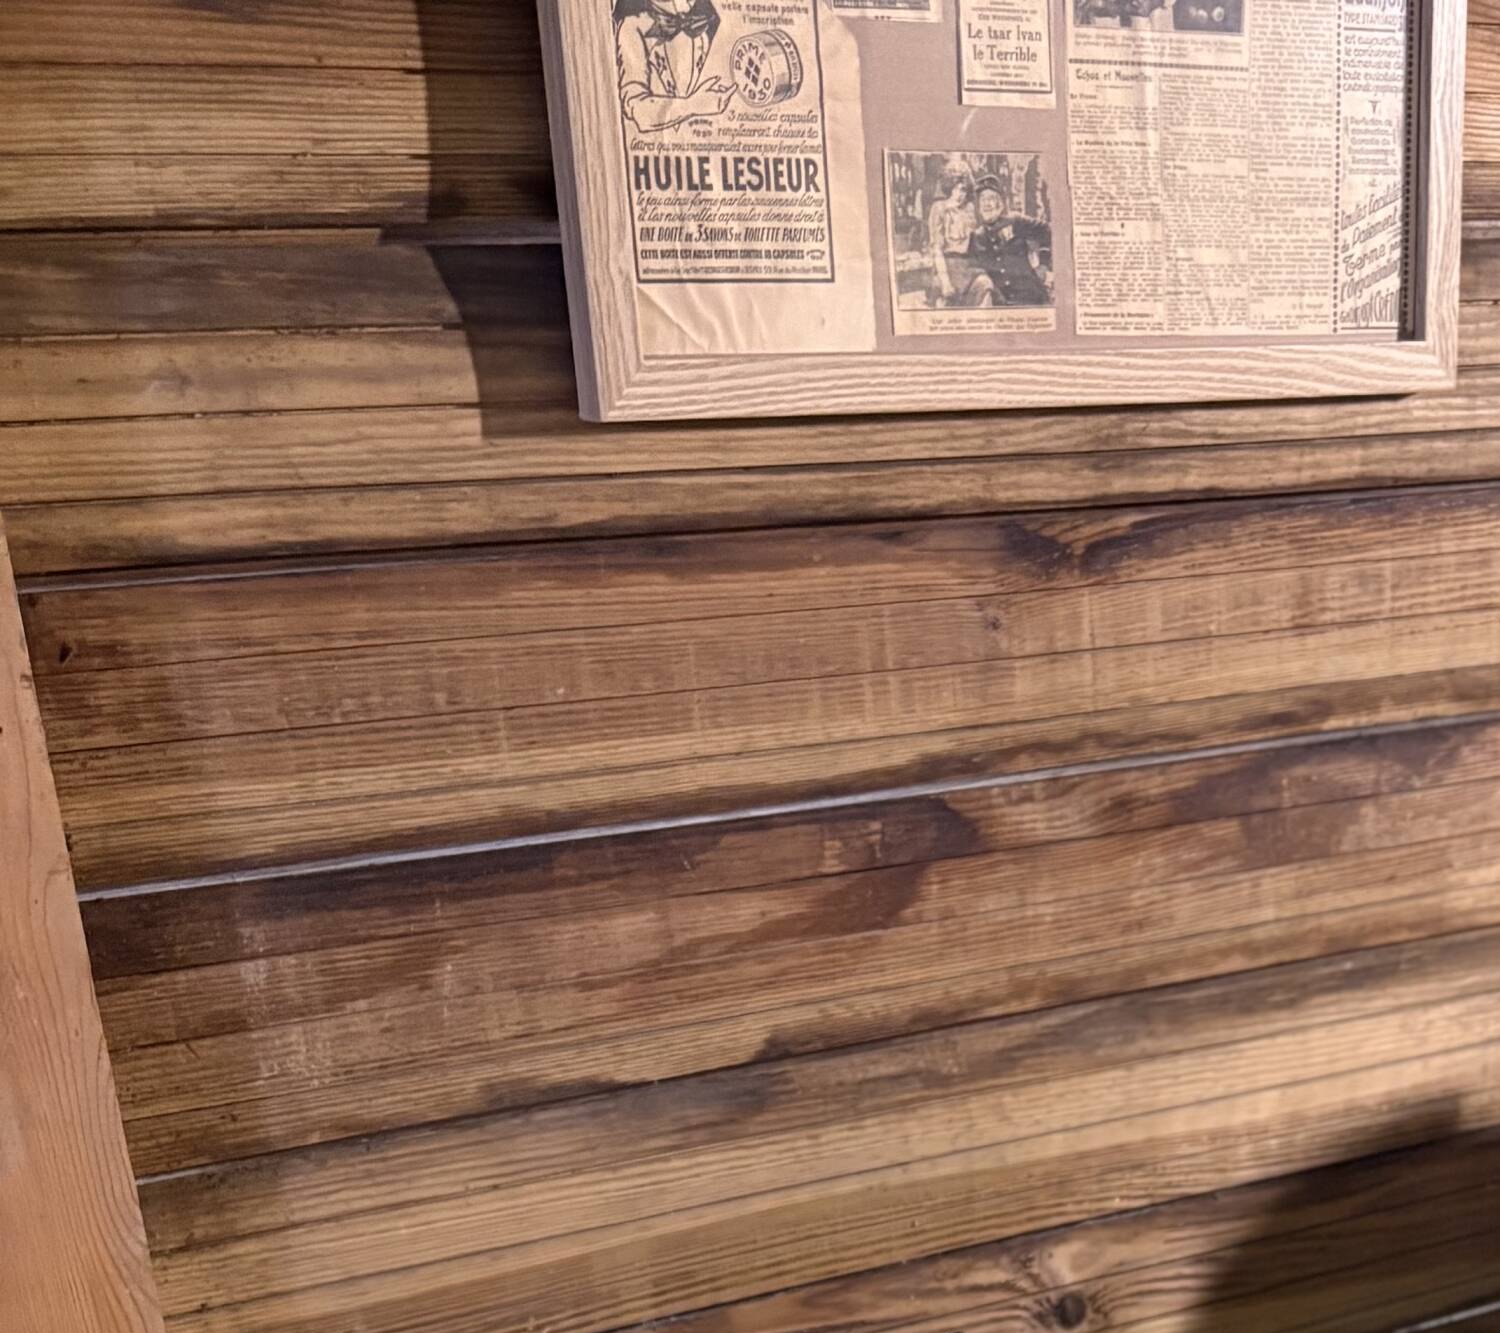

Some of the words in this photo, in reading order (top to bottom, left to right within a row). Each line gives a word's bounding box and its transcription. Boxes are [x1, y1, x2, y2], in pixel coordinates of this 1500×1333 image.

[967, 22, 984, 39] Le
[988, 25, 1012, 41] tsar
[1017, 24, 1043, 42] Ivan
[734, 42, 767, 70] PRIME
[972, 43, 984, 61] le
[986, 43, 1038, 63] Terrible
[633, 155, 714, 191] HUILE
[720, 156, 821, 193] LESIEUR
